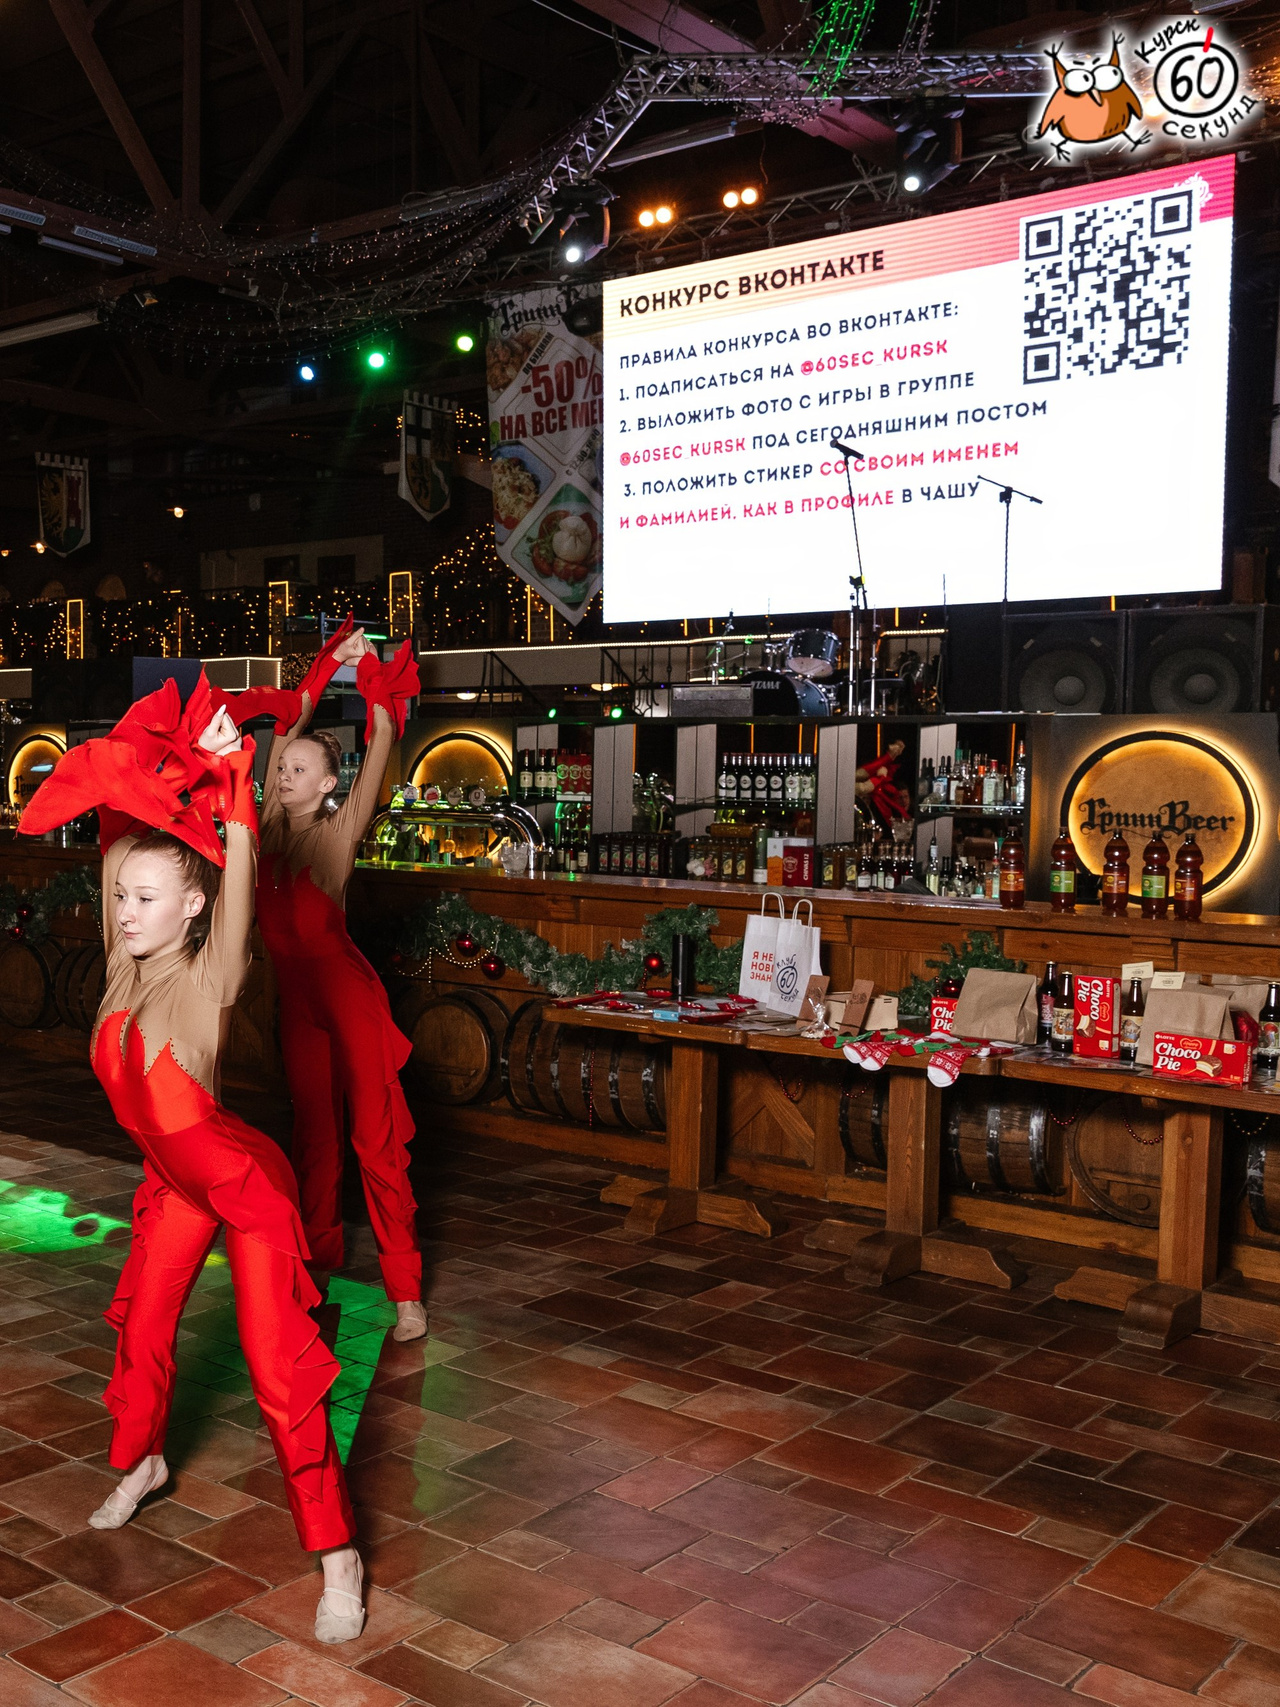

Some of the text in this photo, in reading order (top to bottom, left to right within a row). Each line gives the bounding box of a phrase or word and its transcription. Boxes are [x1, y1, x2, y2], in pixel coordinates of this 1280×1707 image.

[620, 250, 884, 317] КОНКУРС ВКОНТАКТЕ
[522, 331, 555, 375] ПО БУДНЯМ
[620, 302, 959, 369] ПРАВИЛА КОНКУРСА ВО ВКОНТАКТЕ:
[521, 353, 603, 408] -50%
[619, 388, 630, 401] 1.
[635, 367, 763, 399] ПОДПИСАТЬСЯ
[770, 363, 794, 379] НА
[500, 414, 527, 440] НА
[531, 405, 568, 437] ВСЕ
[619, 372, 975, 433] 2. ВЫЛОЖИТЬ ФОТО С ИГРЫ В ГРУППЕ
[752, 432, 790, 449] ПОД
[796, 412, 948, 444] СЕГОДНЯШНИМ
[957, 400, 1047, 425] ПОСТОМ
[624, 441, 1019, 497] 3. ПОЛОЖИТЬ СТИКЕР СО СВОИМ ИМЕНЕМ
[619, 516, 629, 529] И
[743, 502, 777, 518] КАК
[784, 500, 794, 514] В
[801, 490, 894, 512] ПРОФИЛЕ
[901, 488, 912, 503] В
[920, 481, 980, 500] ЧАШУ
[752, 951, 759, 960] Я
[780, 970, 795, 989] 60
[1077, 978, 1091, 1002] Pie
[1090, 979, 1104, 1021] Choco
[1154, 1055, 1181, 1071] Pie
[1155, 1042, 1201, 1060] Choco
